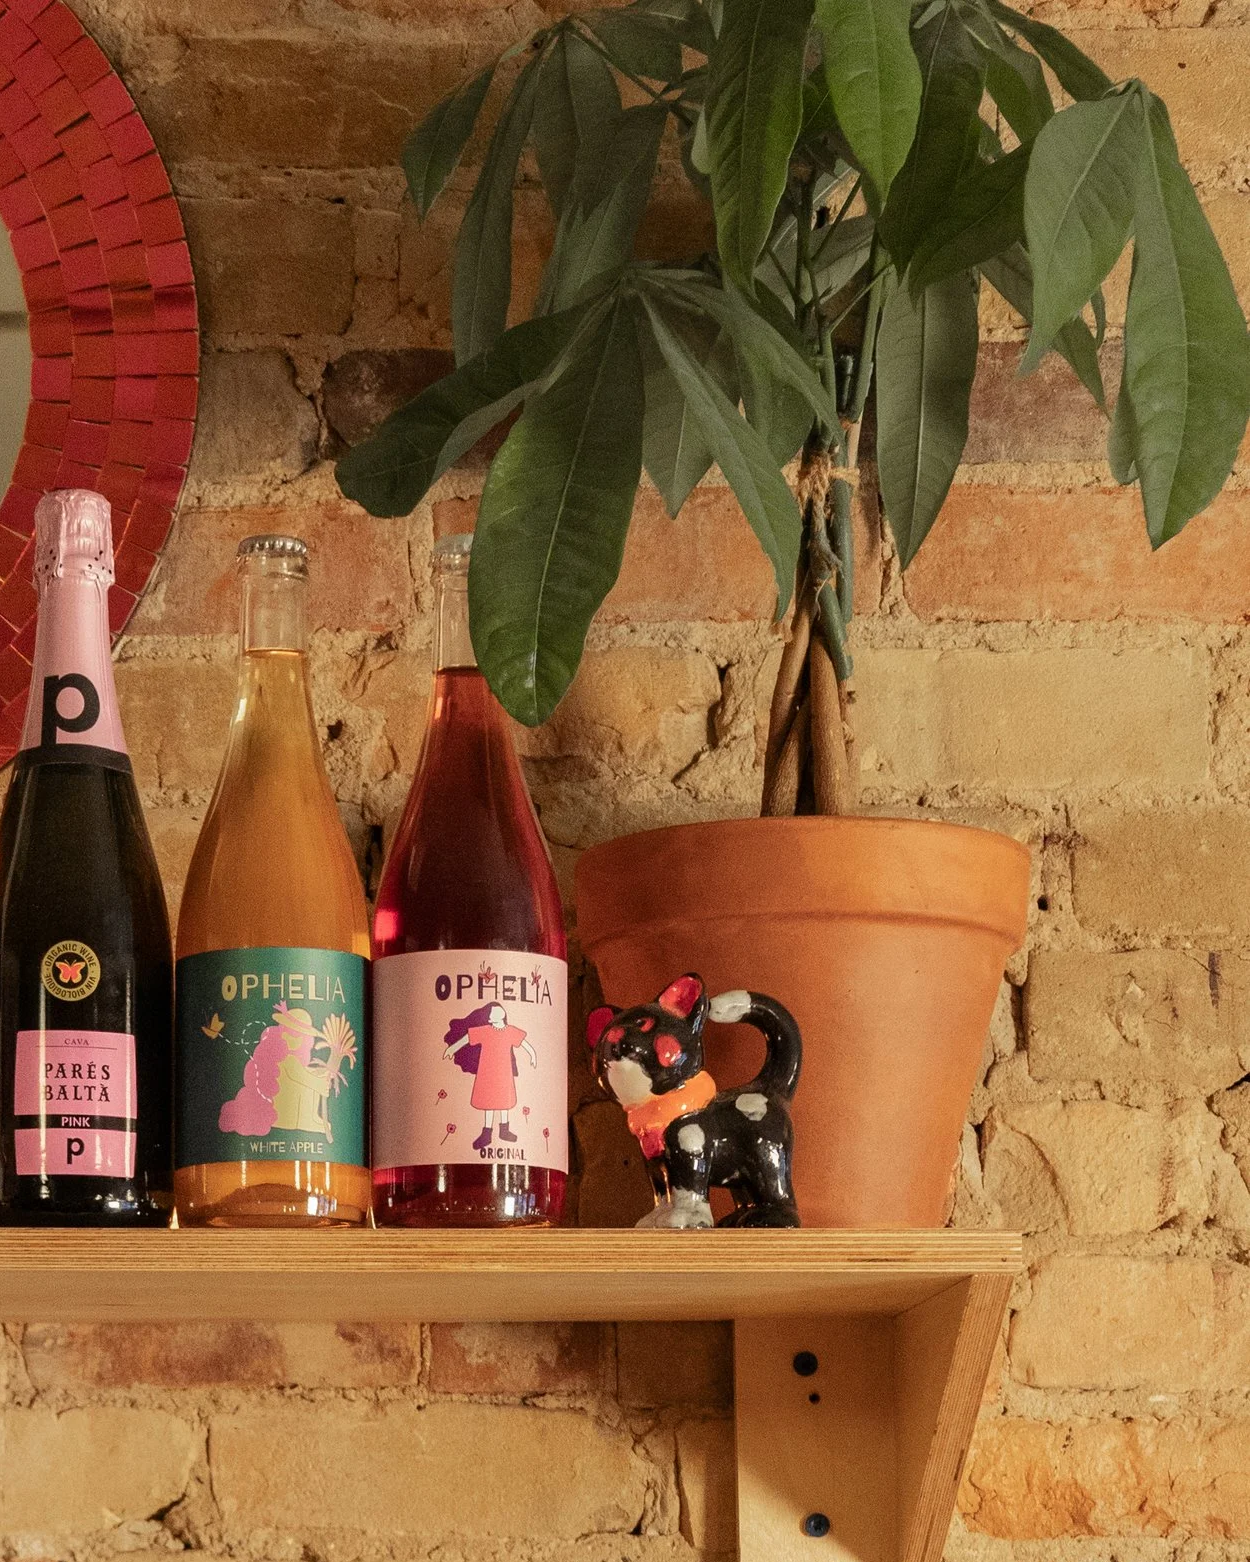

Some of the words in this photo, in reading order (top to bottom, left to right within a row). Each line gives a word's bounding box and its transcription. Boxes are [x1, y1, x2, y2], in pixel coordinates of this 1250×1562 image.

[41, 673, 100, 746] p
[45, 943, 77, 967] ORGANIC
[79, 947, 97, 968] WINE
[44, 972, 86, 998] BIOLOGIQUE
[85, 976, 97, 990] VIN
[221, 973, 346, 1003] OPHELIA
[435, 973, 552, 1006] OPHELIA
[64, 1038, 89, 1046] CAVA
[44, 1061, 111, 1080] PARÉS
[43, 1083, 111, 1102] BALTÀ
[61, 1116, 90, 1128] PINK
[67, 1137, 85, 1165] p
[249, 1141, 285, 1154] WHITE
[289, 1142, 323, 1154] APPLE
[479, 1147, 527, 1161] ORIGINAL
